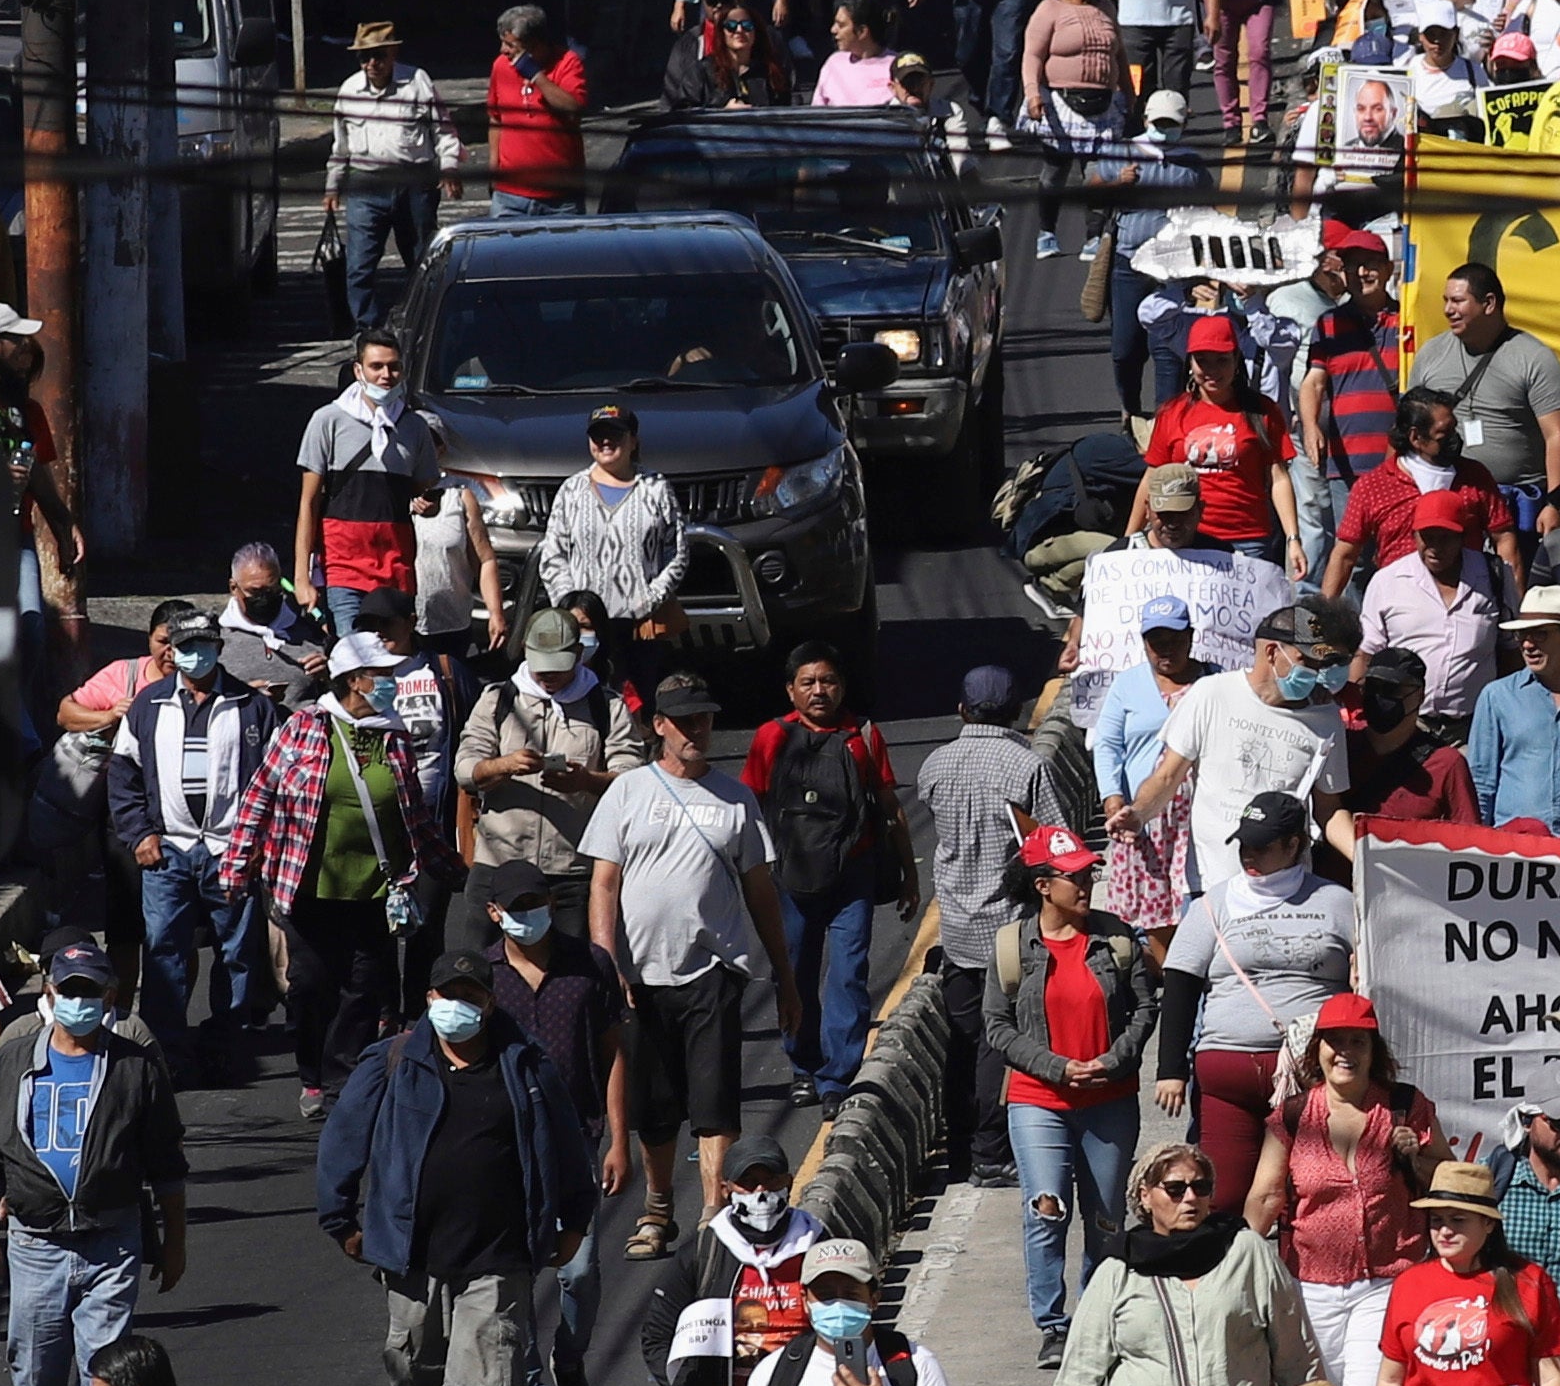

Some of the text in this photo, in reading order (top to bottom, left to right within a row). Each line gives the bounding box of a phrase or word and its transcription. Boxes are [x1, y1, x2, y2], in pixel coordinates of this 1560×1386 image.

[1090, 559, 1257, 584] LAS COMUNIDADES
[1092, 585, 1114, 604] DE
[1076, 695, 1096, 710] DE
[1445, 920, 1519, 964] NO
[1473, 1055, 1525, 1100] EL
[817, 1243, 854, 1259] NYC
[765, 1297, 798, 1312] VIVE
